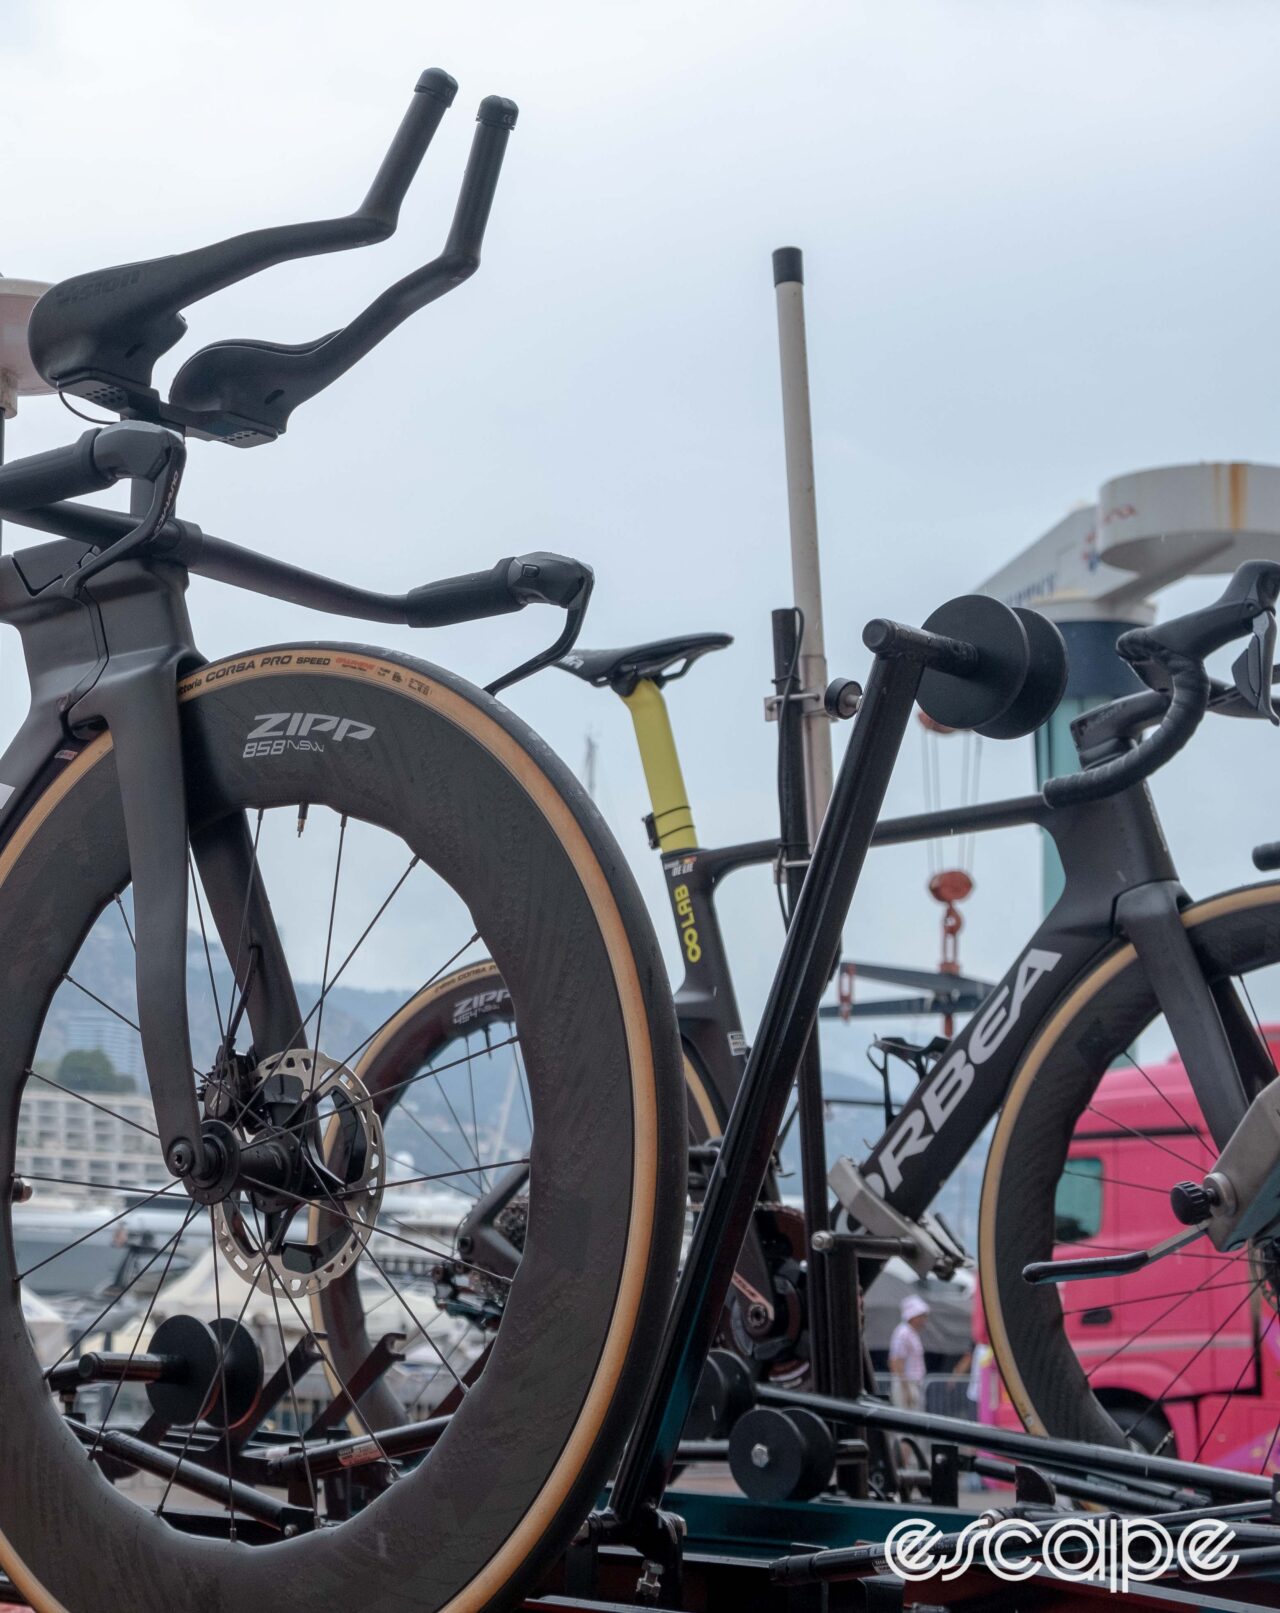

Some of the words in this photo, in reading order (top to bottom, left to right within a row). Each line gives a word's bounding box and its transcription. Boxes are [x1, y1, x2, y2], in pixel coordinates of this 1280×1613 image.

[205, 660, 255, 683] CORSA
[260, 655, 292, 668] PRO
[296, 656, 331, 666] SPEED
[247, 712, 376, 742] ZIPP
[242, 739, 286, 759] 858
[286, 740, 325, 753] NSW
[452, 989, 512, 1018] ZIPP
